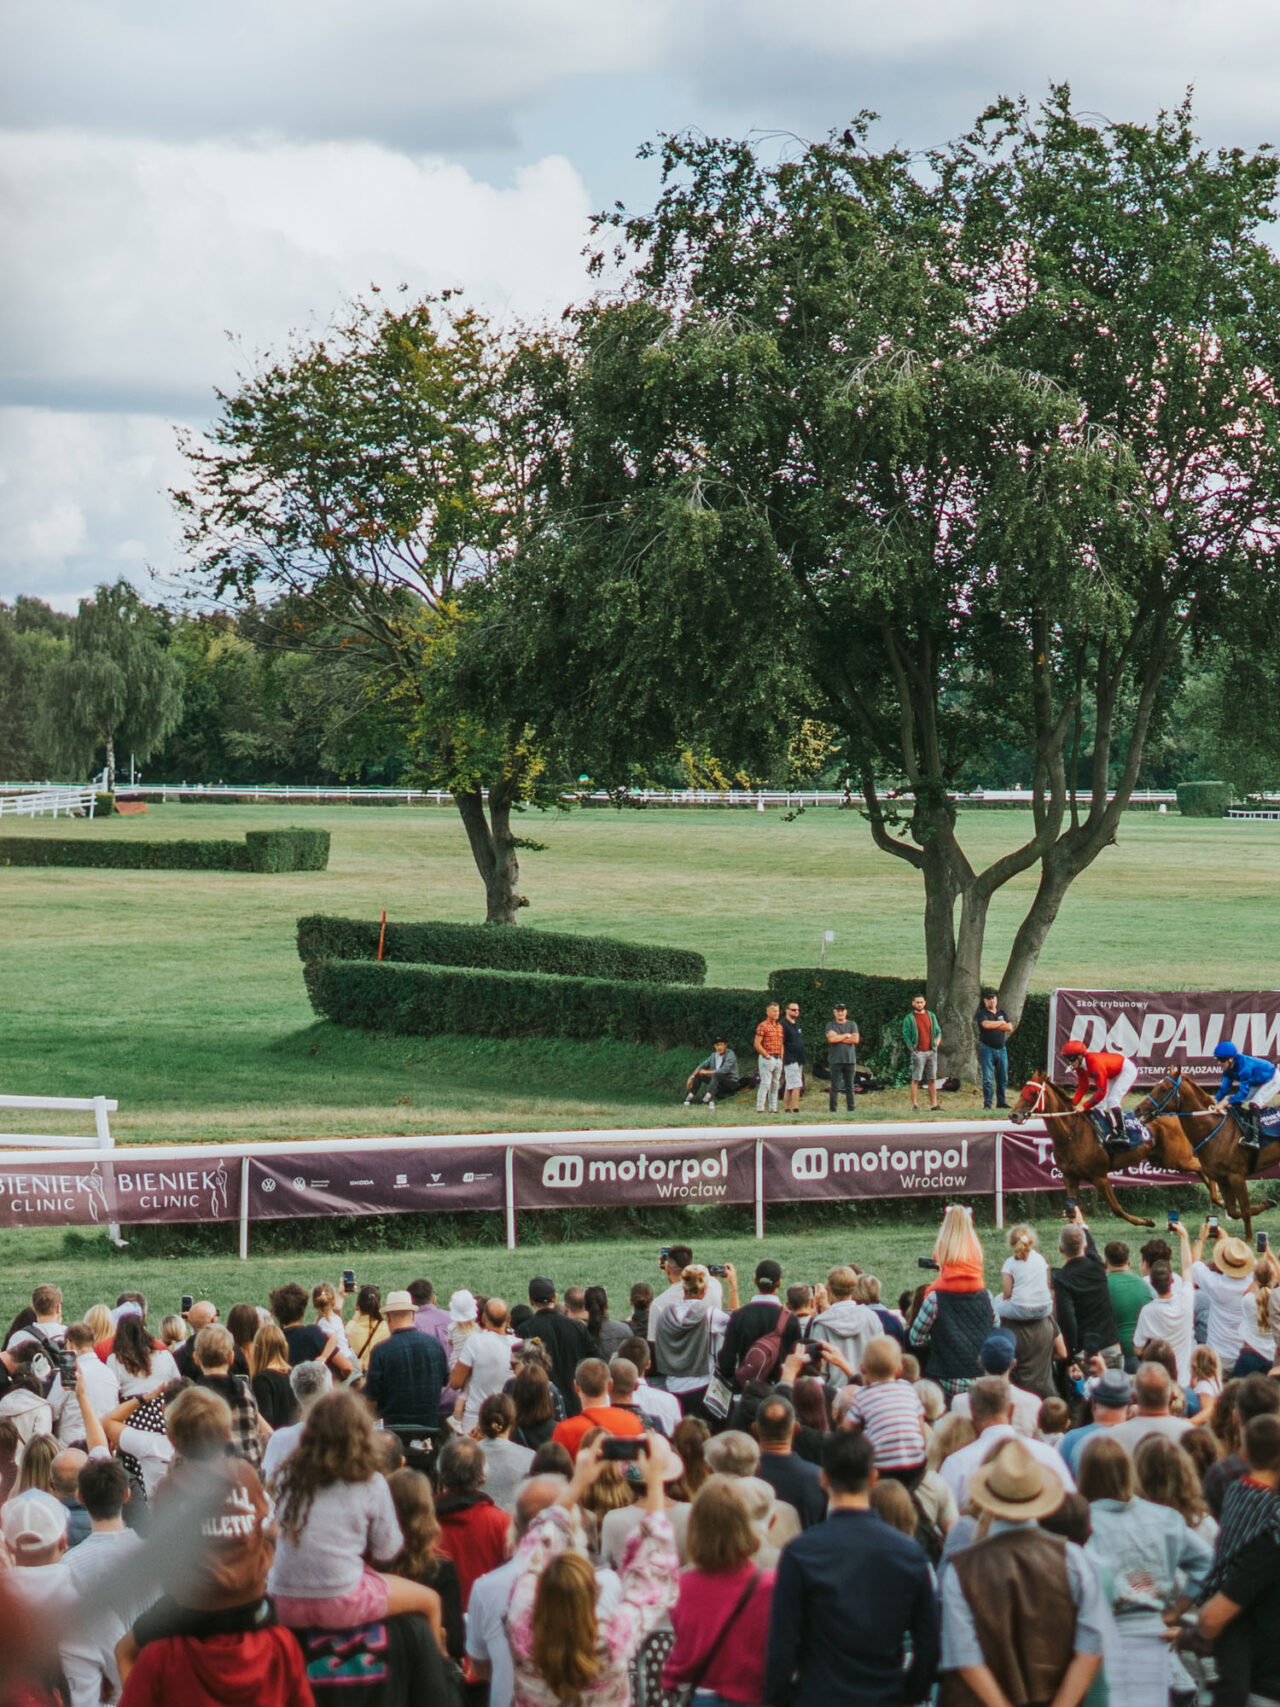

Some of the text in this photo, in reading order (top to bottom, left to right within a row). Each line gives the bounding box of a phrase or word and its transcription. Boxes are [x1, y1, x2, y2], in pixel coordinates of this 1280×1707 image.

[1100, 1000, 1148, 1009] trybunowy
[833, 1139, 968, 1175] motorpol
[589, 1148, 728, 1184] motorpol
[118, 1171, 216, 1191] BIENIEK
[900, 1172, 967, 1188] Wrocław
[656, 1182, 727, 1198] Wrocław
[11, 1198, 76, 1212] CLINIC
[140, 1195, 200, 1208] CLINIC
